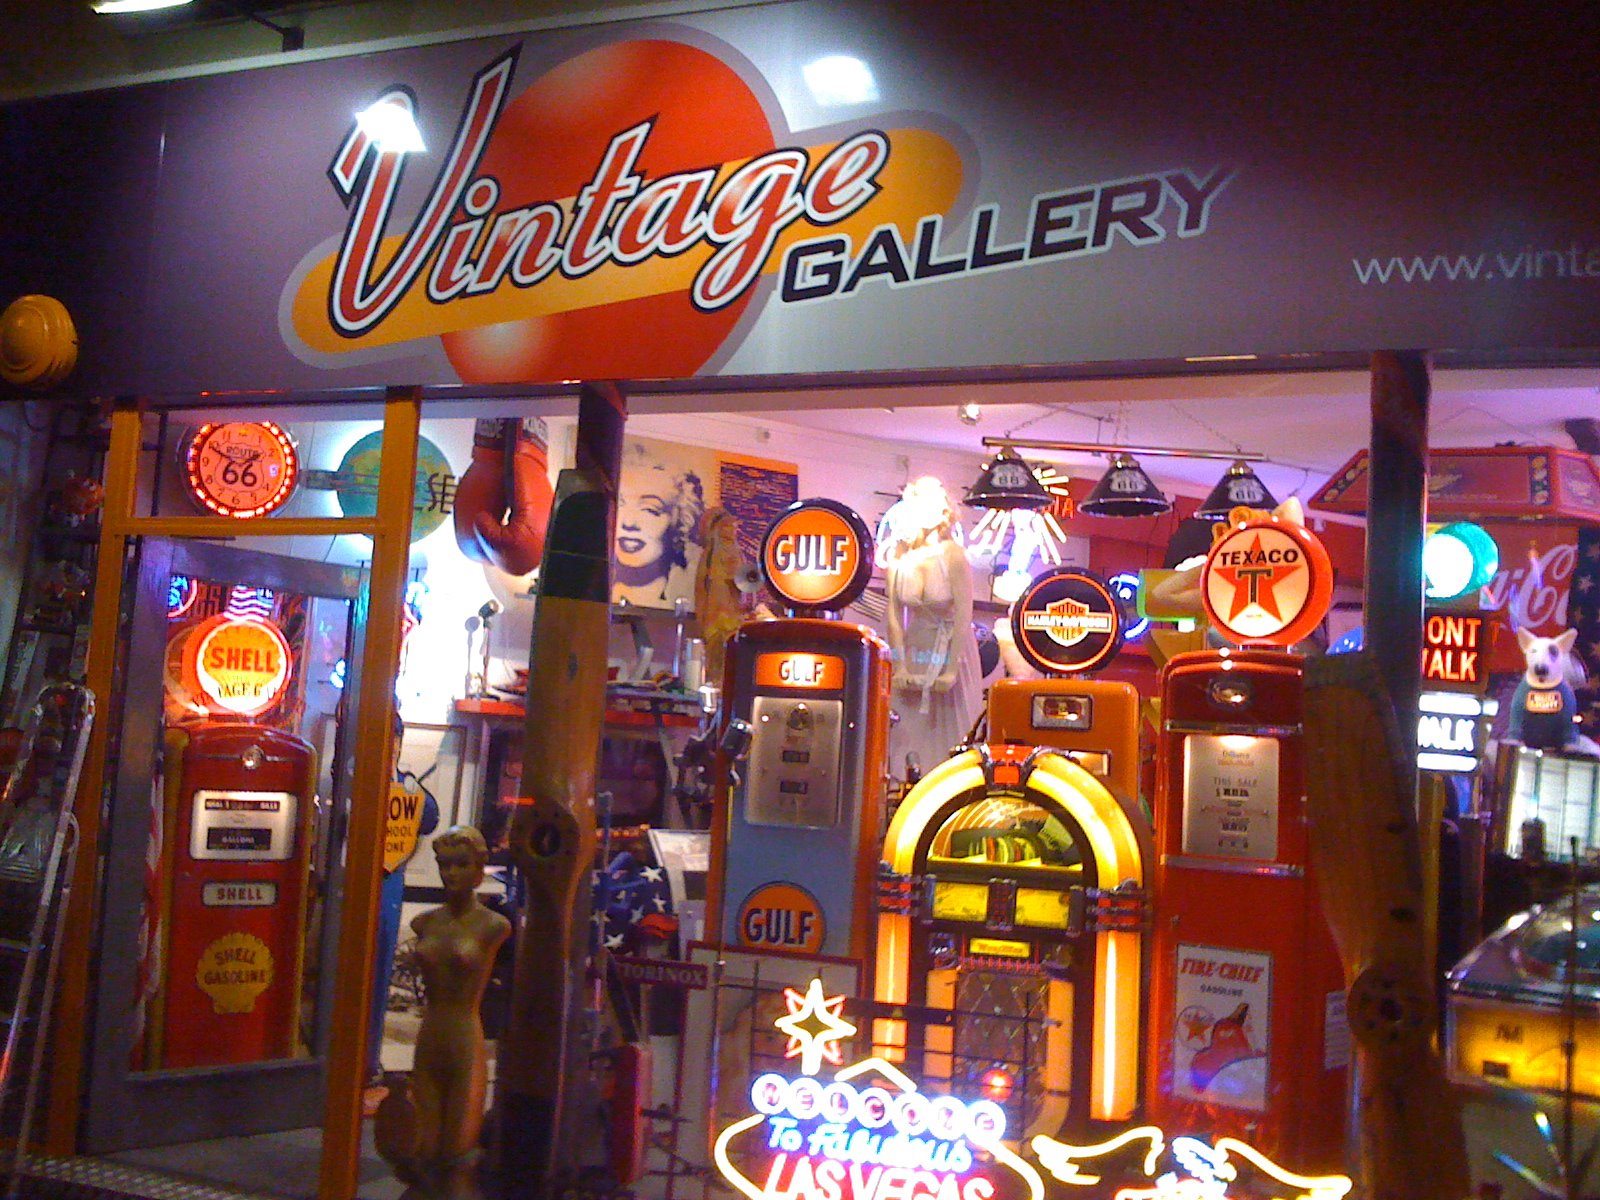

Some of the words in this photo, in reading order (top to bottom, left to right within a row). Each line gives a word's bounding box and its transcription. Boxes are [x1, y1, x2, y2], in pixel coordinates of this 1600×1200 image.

[326, 41, 890, 338] Vintage
[776, 166, 1238, 303] GALLERY
[222, 461, 257, 487] 66
[773, 534, 848, 576] GULF
[1220, 548, 1299, 566] TEXACO
[1426, 616, 1482, 647] ONT
[210, 646, 275, 673] SHELL
[778, 660, 824, 684] GULF
[1417, 715, 1475, 752] WALK
[217, 888, 263, 900] SHELL
[745, 908, 815, 945] GULF
[214, 947, 256, 966] SHELL
[204, 970, 266, 985] GASOLINE
[762, 1152, 846, 1200] LAS
